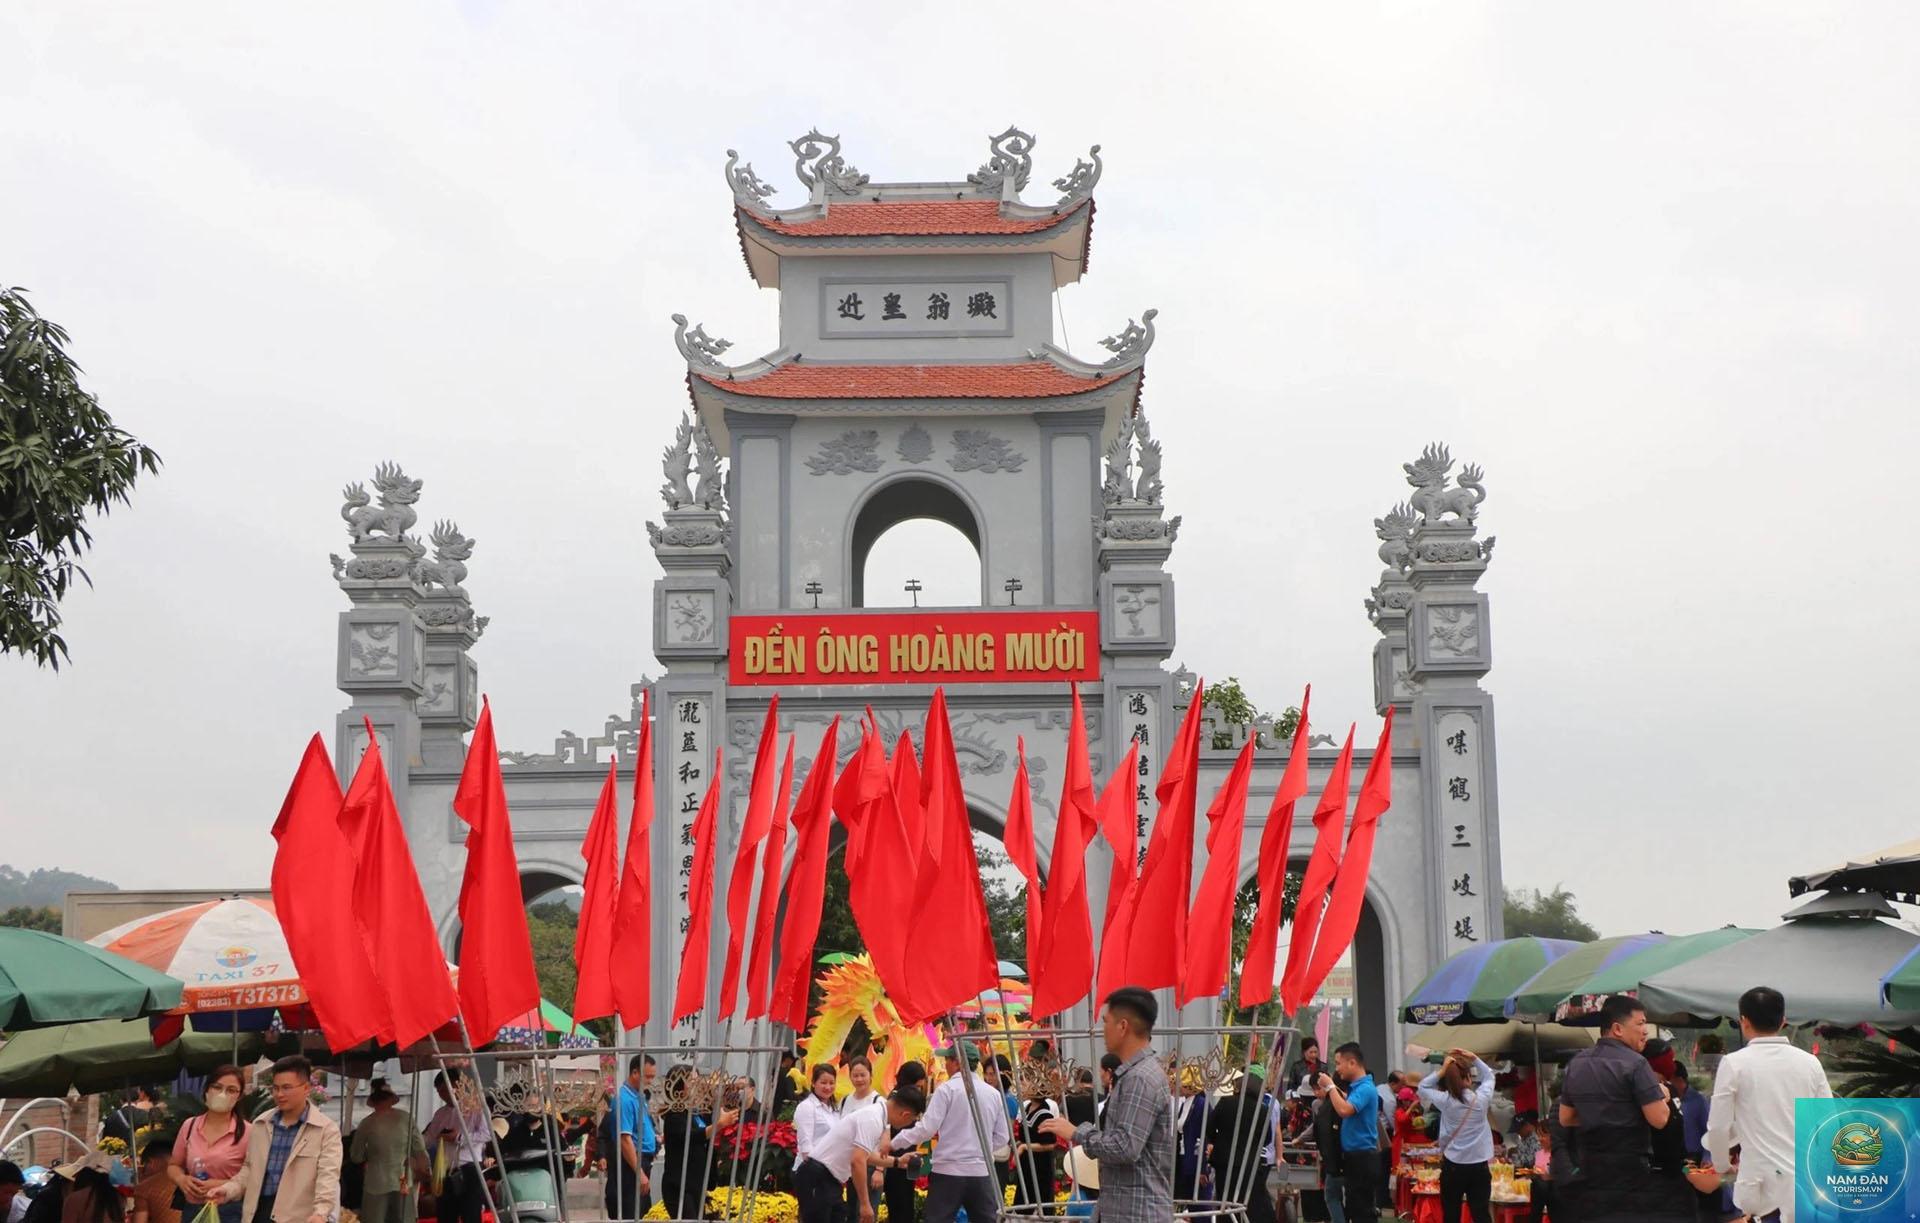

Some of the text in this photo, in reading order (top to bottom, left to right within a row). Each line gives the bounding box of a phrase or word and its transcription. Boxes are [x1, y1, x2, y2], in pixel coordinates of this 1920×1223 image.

[744, 622, 1085, 674] ĐỀN ÔNG HOÀNG MƯỜI
[198, 964, 279, 981] TAXI 37
[234, 984, 300, 1005] 737373
